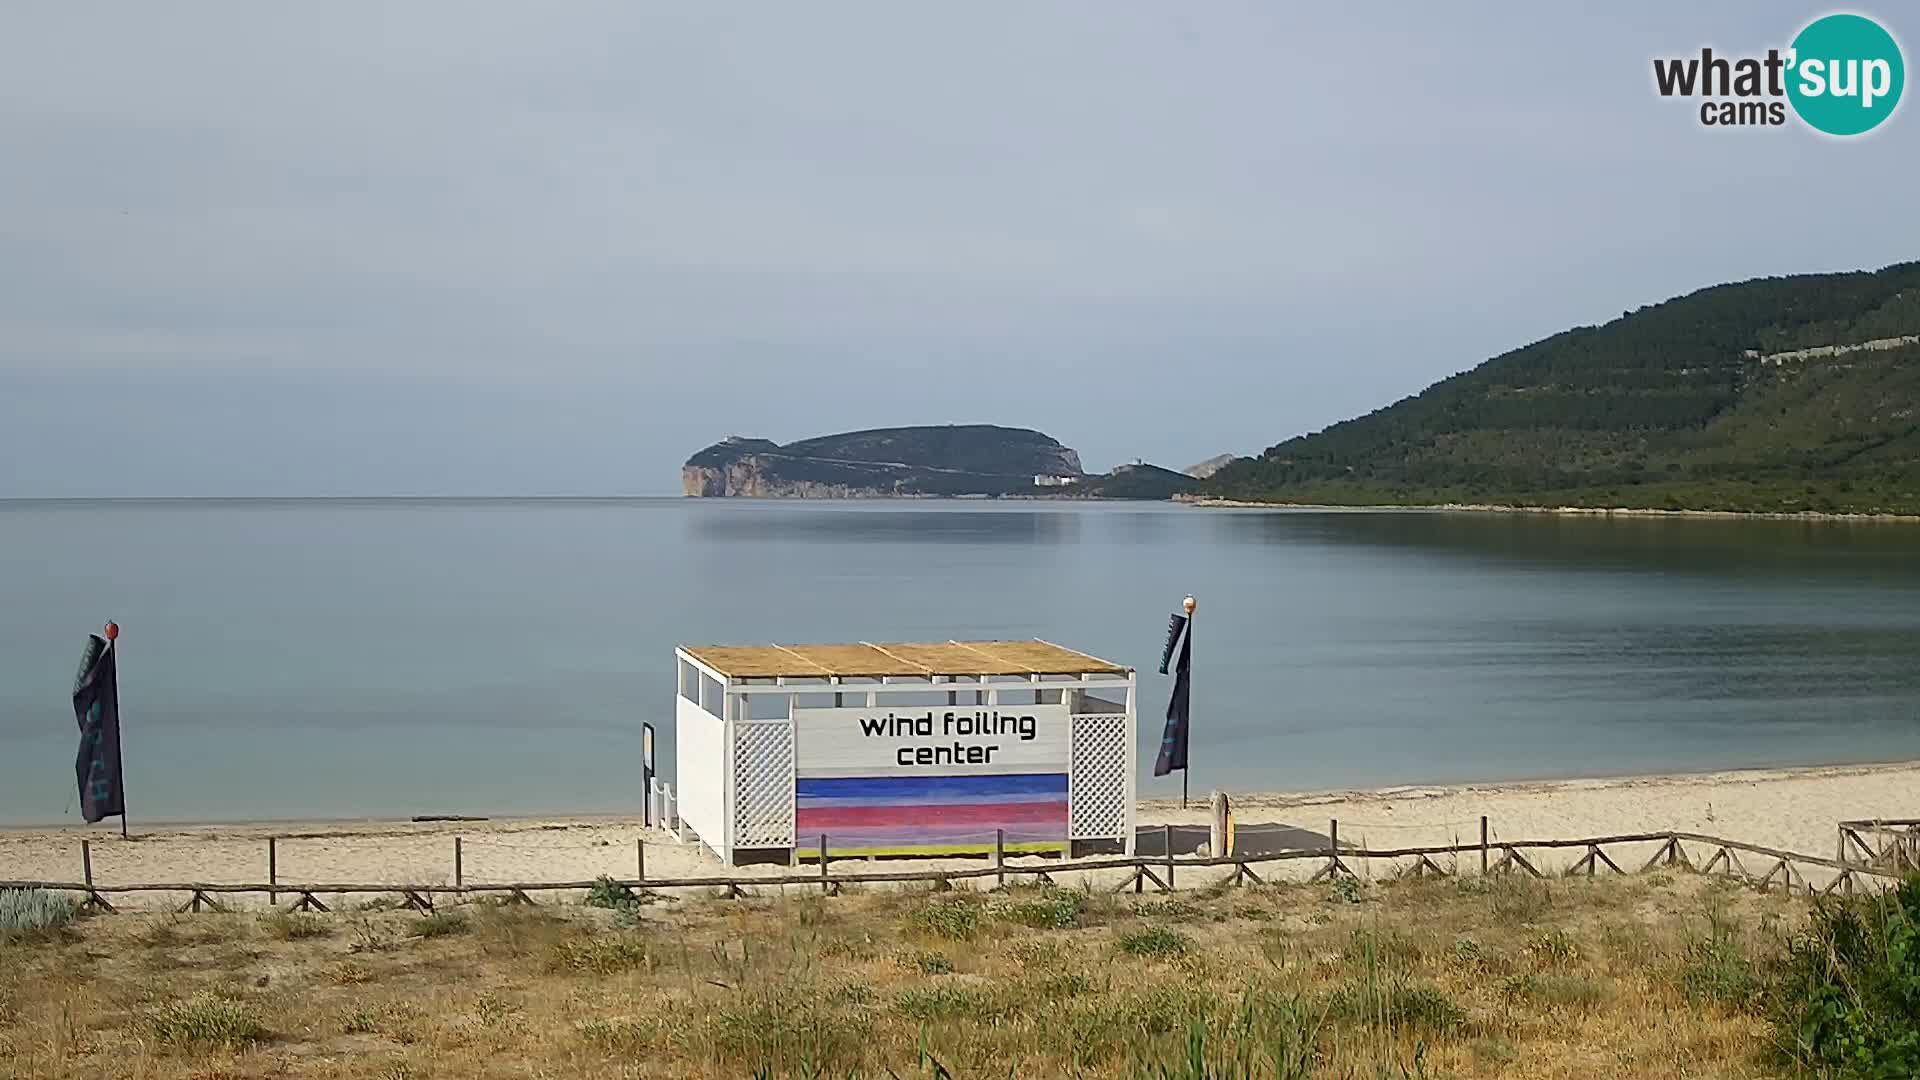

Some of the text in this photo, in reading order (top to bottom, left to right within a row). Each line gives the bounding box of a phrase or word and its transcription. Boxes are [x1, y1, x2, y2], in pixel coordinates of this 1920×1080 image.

[859, 711, 1036, 740] wind foiling
[897, 741, 999, 766] center
